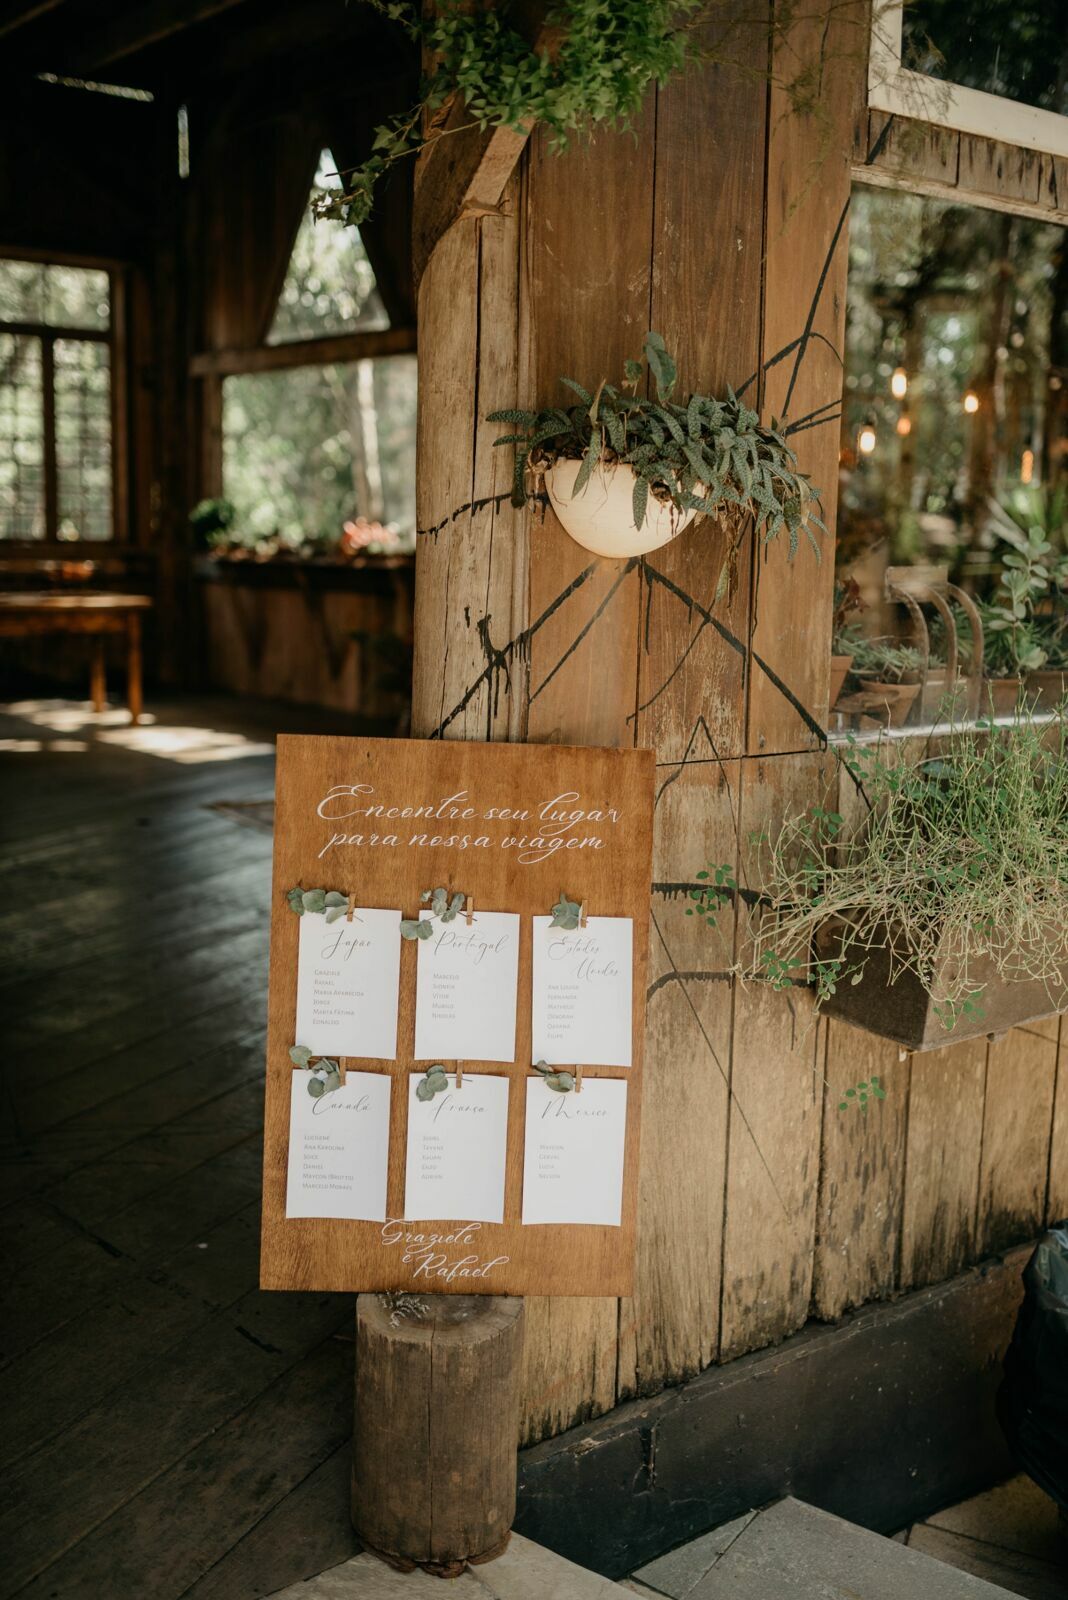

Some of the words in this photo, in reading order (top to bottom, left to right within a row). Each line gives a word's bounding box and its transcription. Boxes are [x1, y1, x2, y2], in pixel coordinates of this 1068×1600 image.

[316, 784, 482, 820] Encontre
[484, 806, 534, 821] seu
[538, 792, 623, 836] lugar
[318, 831, 401, 858] para
[408, 833, 493, 850] nossa
[501, 833, 607, 865] viagem
[434, 931, 510, 966] Portugal
[547, 935, 599, 960] Estados
[381, 1217, 481, 1254] Graziele
[402, 1254, 411, 1263] e
[413, 1253, 510, 1282] Rafael
